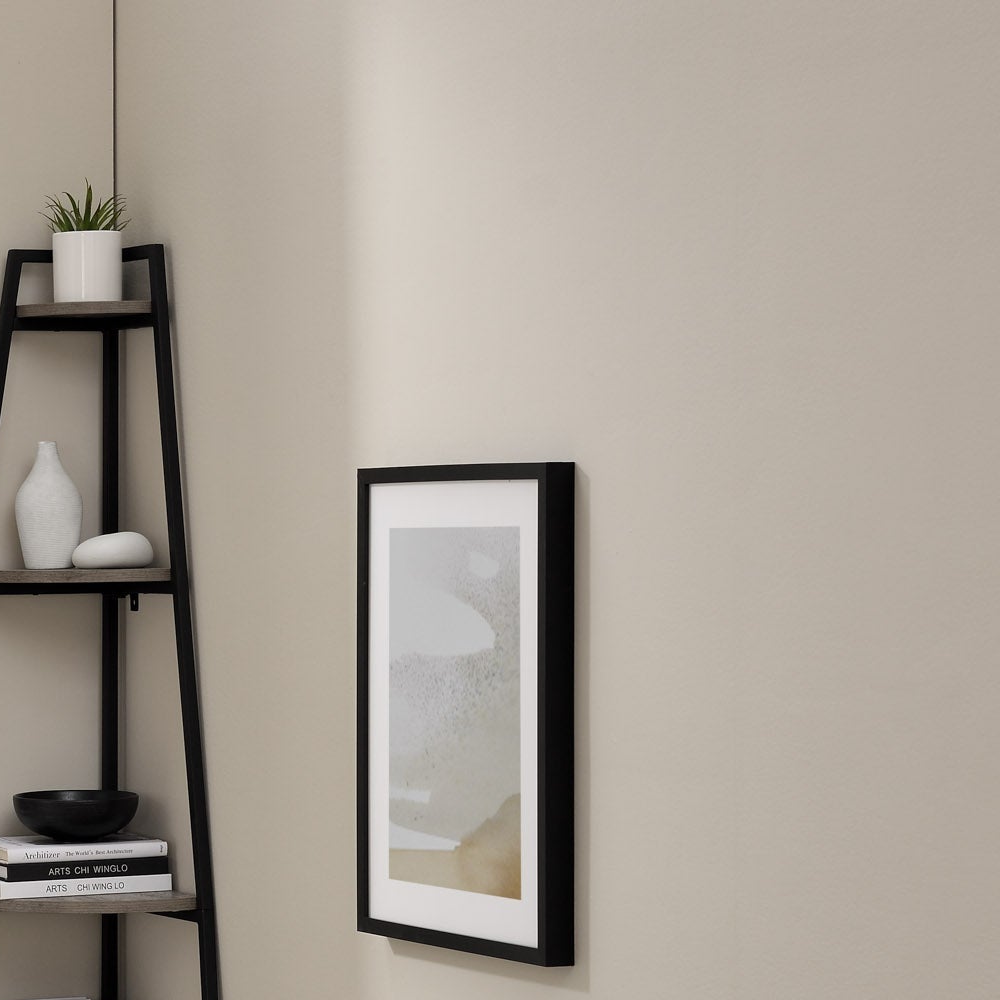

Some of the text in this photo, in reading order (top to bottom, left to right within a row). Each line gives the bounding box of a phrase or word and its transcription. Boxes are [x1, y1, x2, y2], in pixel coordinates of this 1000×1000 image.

[24, 851, 60, 860] Architizer
[48, 864, 128, 876] ARTS CHI WINGLO
[46, 882, 125, 894] ARTS CHI WING LO
